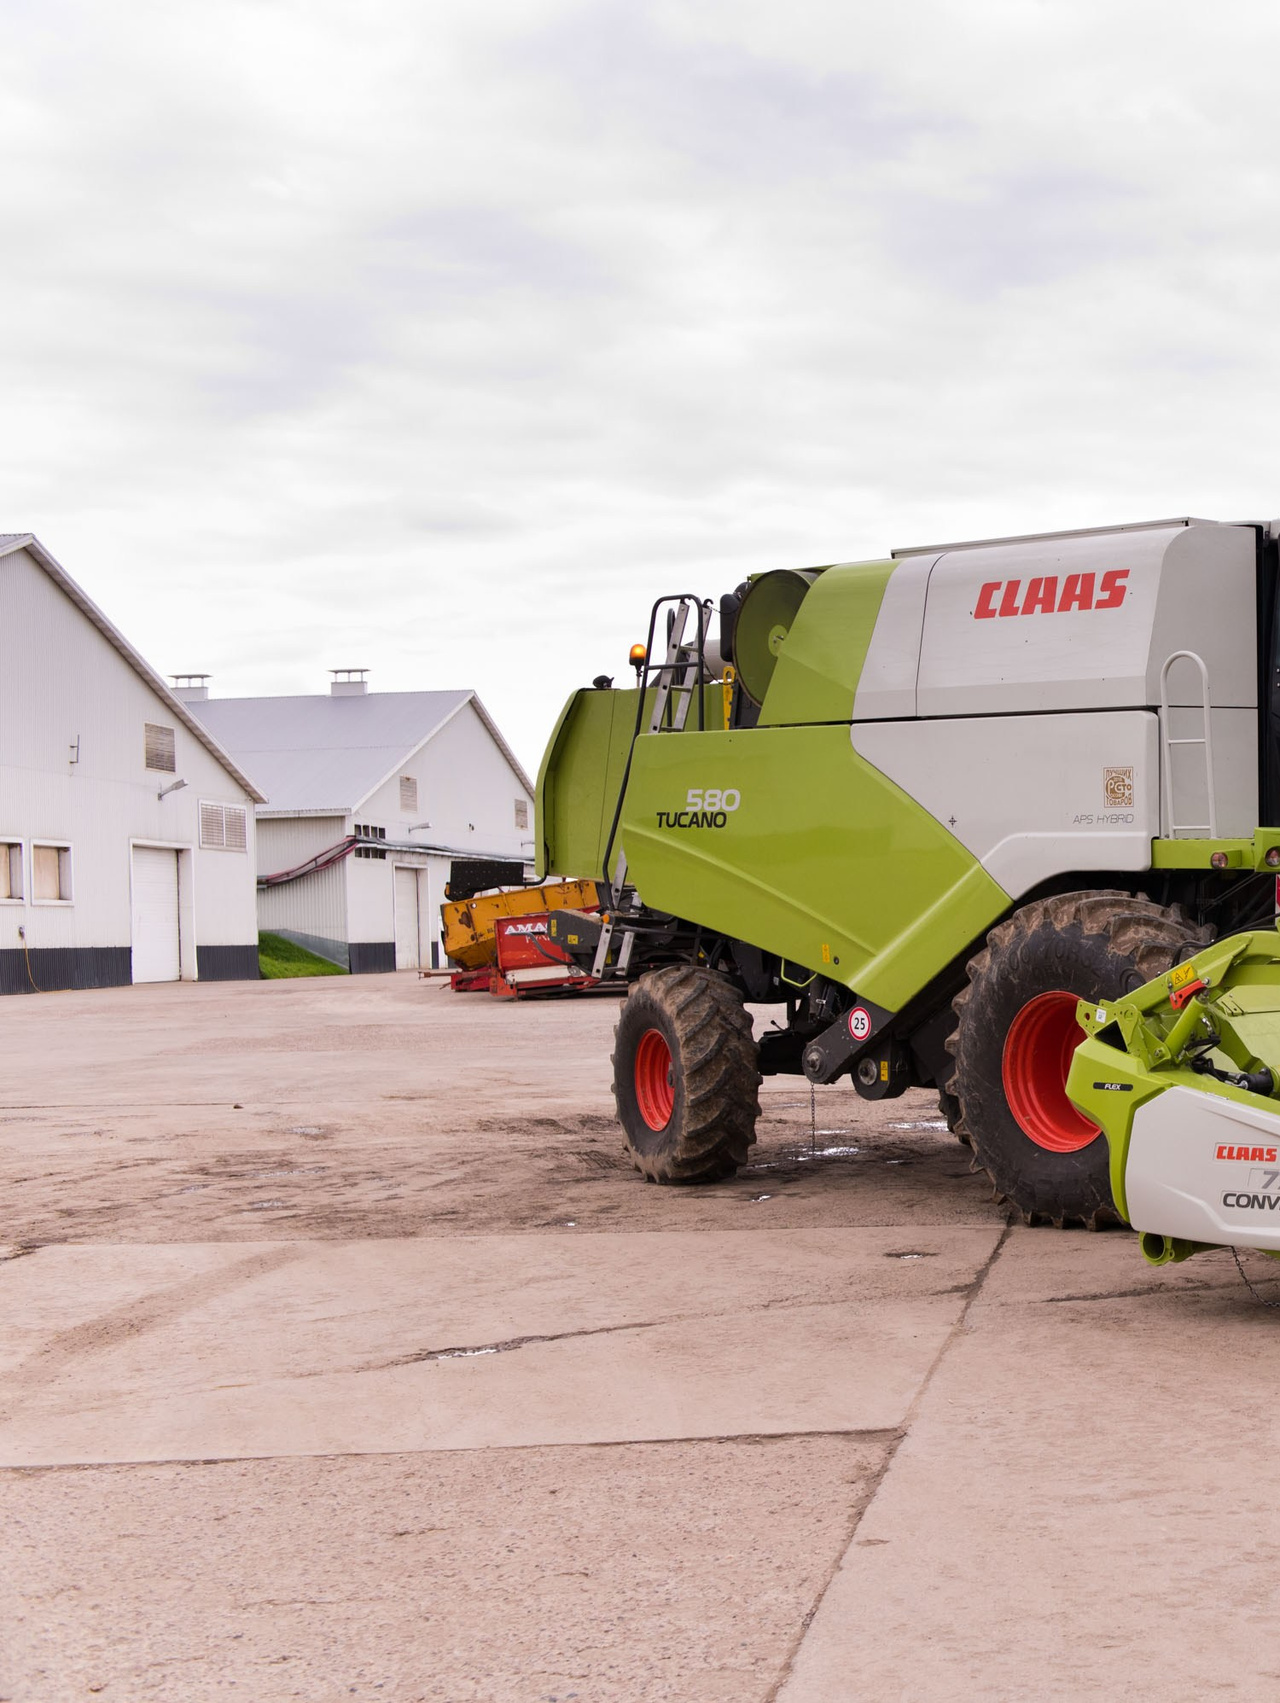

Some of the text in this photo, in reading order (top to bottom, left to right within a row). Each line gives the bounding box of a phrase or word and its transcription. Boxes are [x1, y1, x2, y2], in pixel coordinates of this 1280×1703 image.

[973, 569, 1130, 620] CLAAS
[685, 788, 741, 812] 580
[656, 812, 727, 828] TUCANO
[1072, 813, 1135, 824] APS HYBRID
[505, 922, 548, 934] AMA
[854, 1017, 866, 1030] 25
[1216, 1145, 1277, 1162] CLAAS
